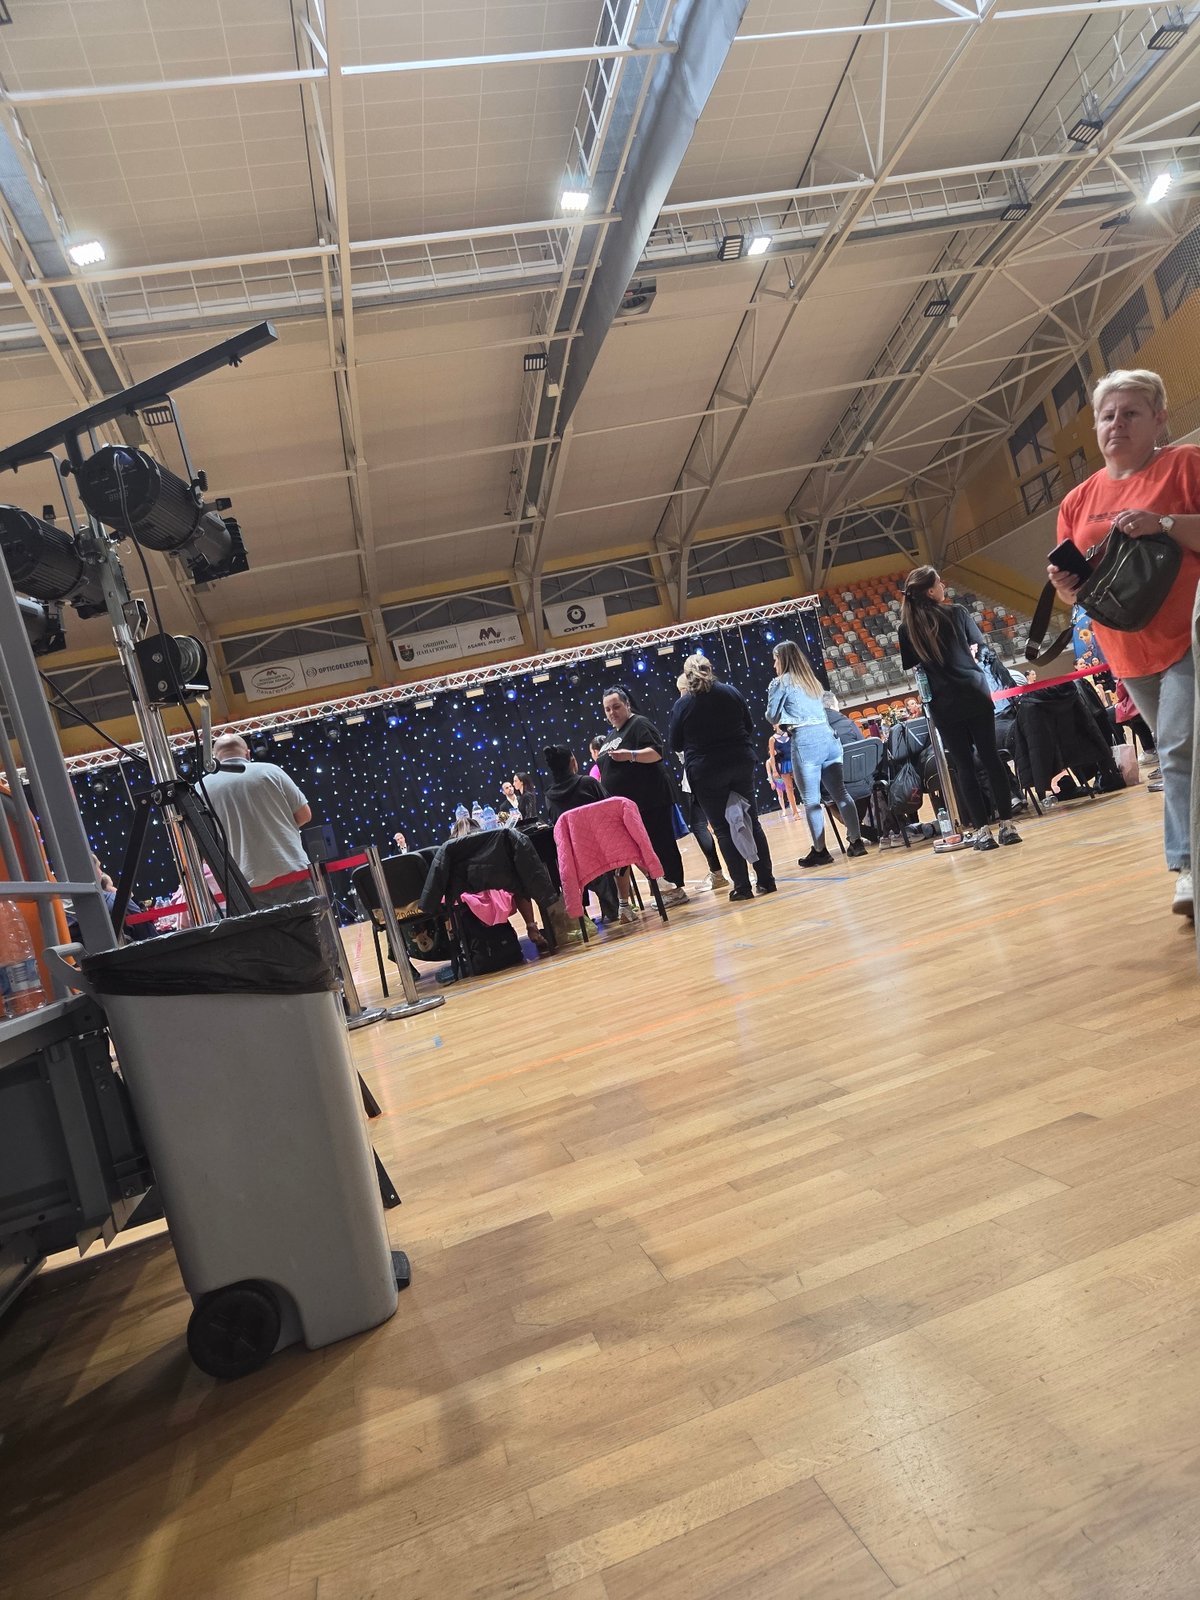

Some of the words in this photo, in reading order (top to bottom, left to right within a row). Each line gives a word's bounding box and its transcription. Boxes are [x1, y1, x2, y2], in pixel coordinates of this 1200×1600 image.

[563, 622, 596, 633] OPTIX
[422, 639, 449, 648] ОБЩИНА
[488, 638, 506, 646] MEDET
[416, 643, 457, 656] ПАНАГЮРИЩЕ
[318, 659, 369, 674] OPTICOELECTRON
